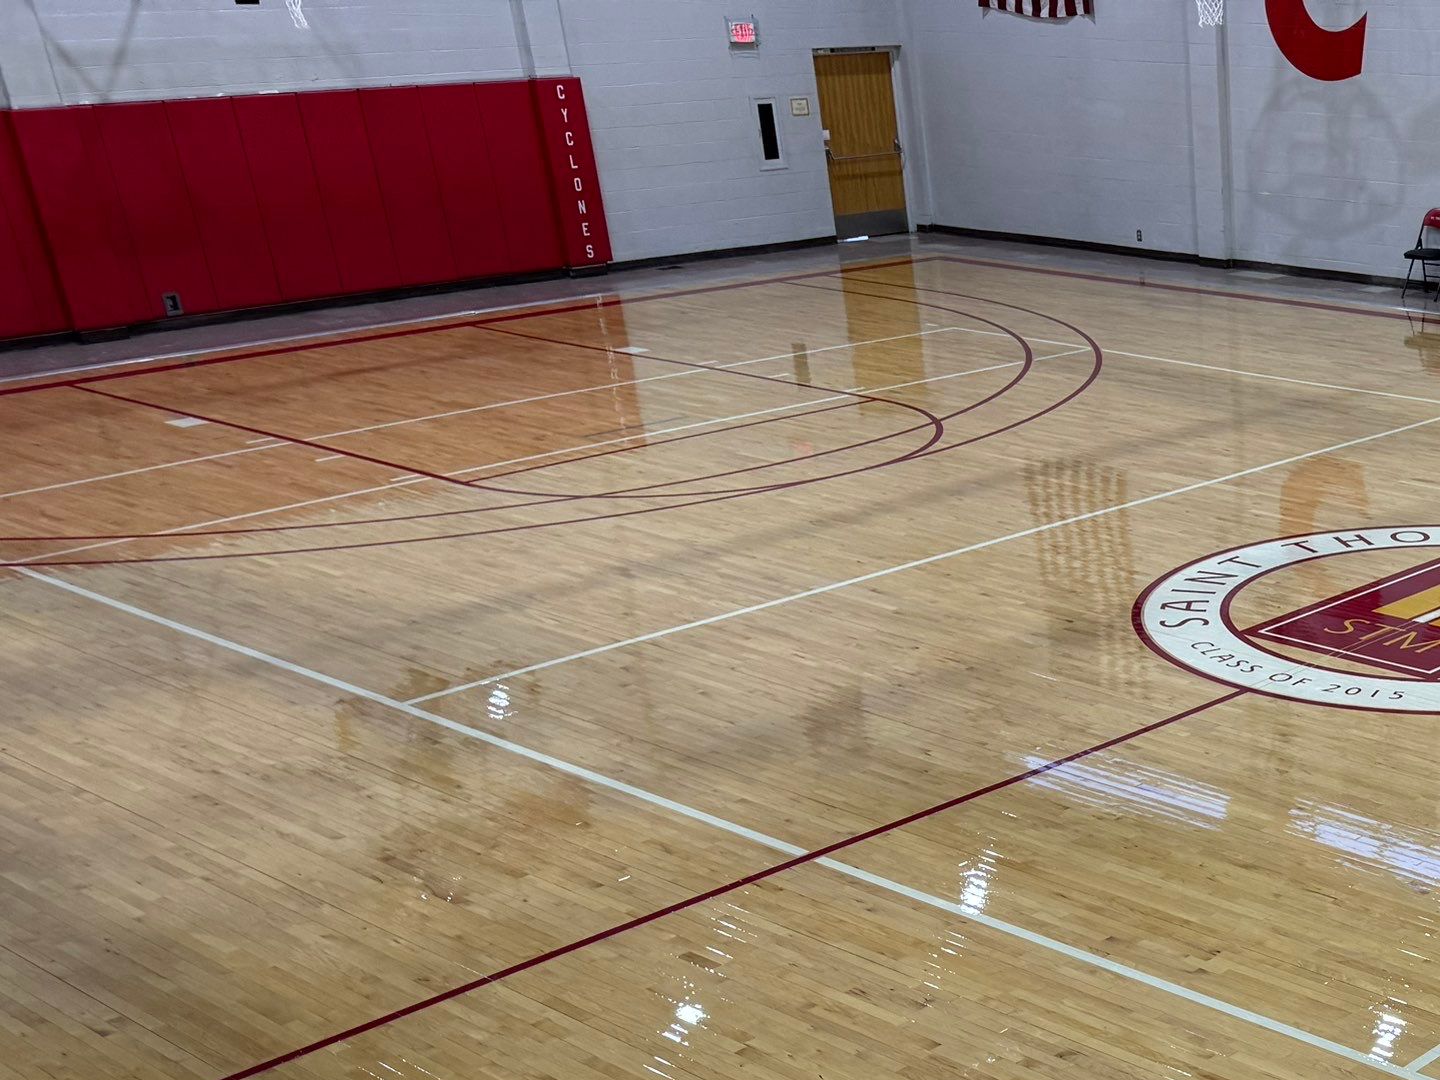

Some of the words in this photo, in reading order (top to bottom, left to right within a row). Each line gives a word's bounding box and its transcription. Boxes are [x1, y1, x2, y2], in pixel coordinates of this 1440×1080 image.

[556, 85, 594, 258] CYCLONES
[1160, 556, 1262, 628] SAINT
[1191, 641, 1263, 674] CLASS
[1268, 672, 1312, 686] OF
[1321, 683, 1405, 700] 2015
